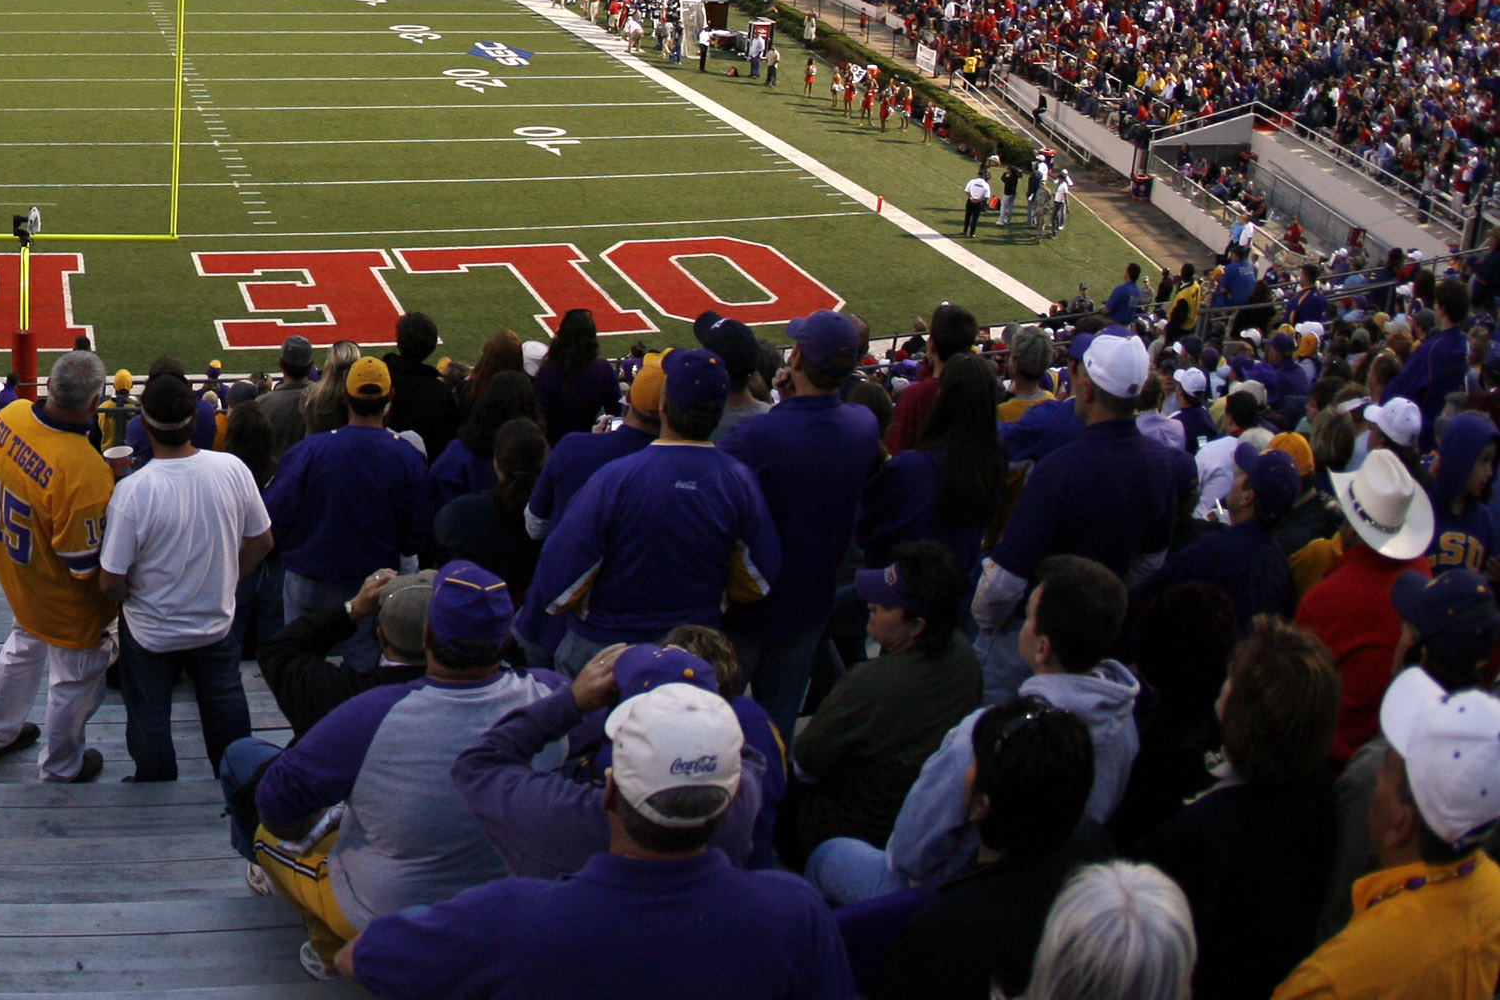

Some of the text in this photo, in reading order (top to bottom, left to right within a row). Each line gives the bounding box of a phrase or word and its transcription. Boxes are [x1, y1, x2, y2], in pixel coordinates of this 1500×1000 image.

[389, 24, 442, 45] 30
[475, 42, 530, 67] SEC
[442, 68, 507, 94] 20
[513, 126, 581, 157] 10
[191, 236, 846, 350] OLE
[7, 435, 54, 488] TIGERS
